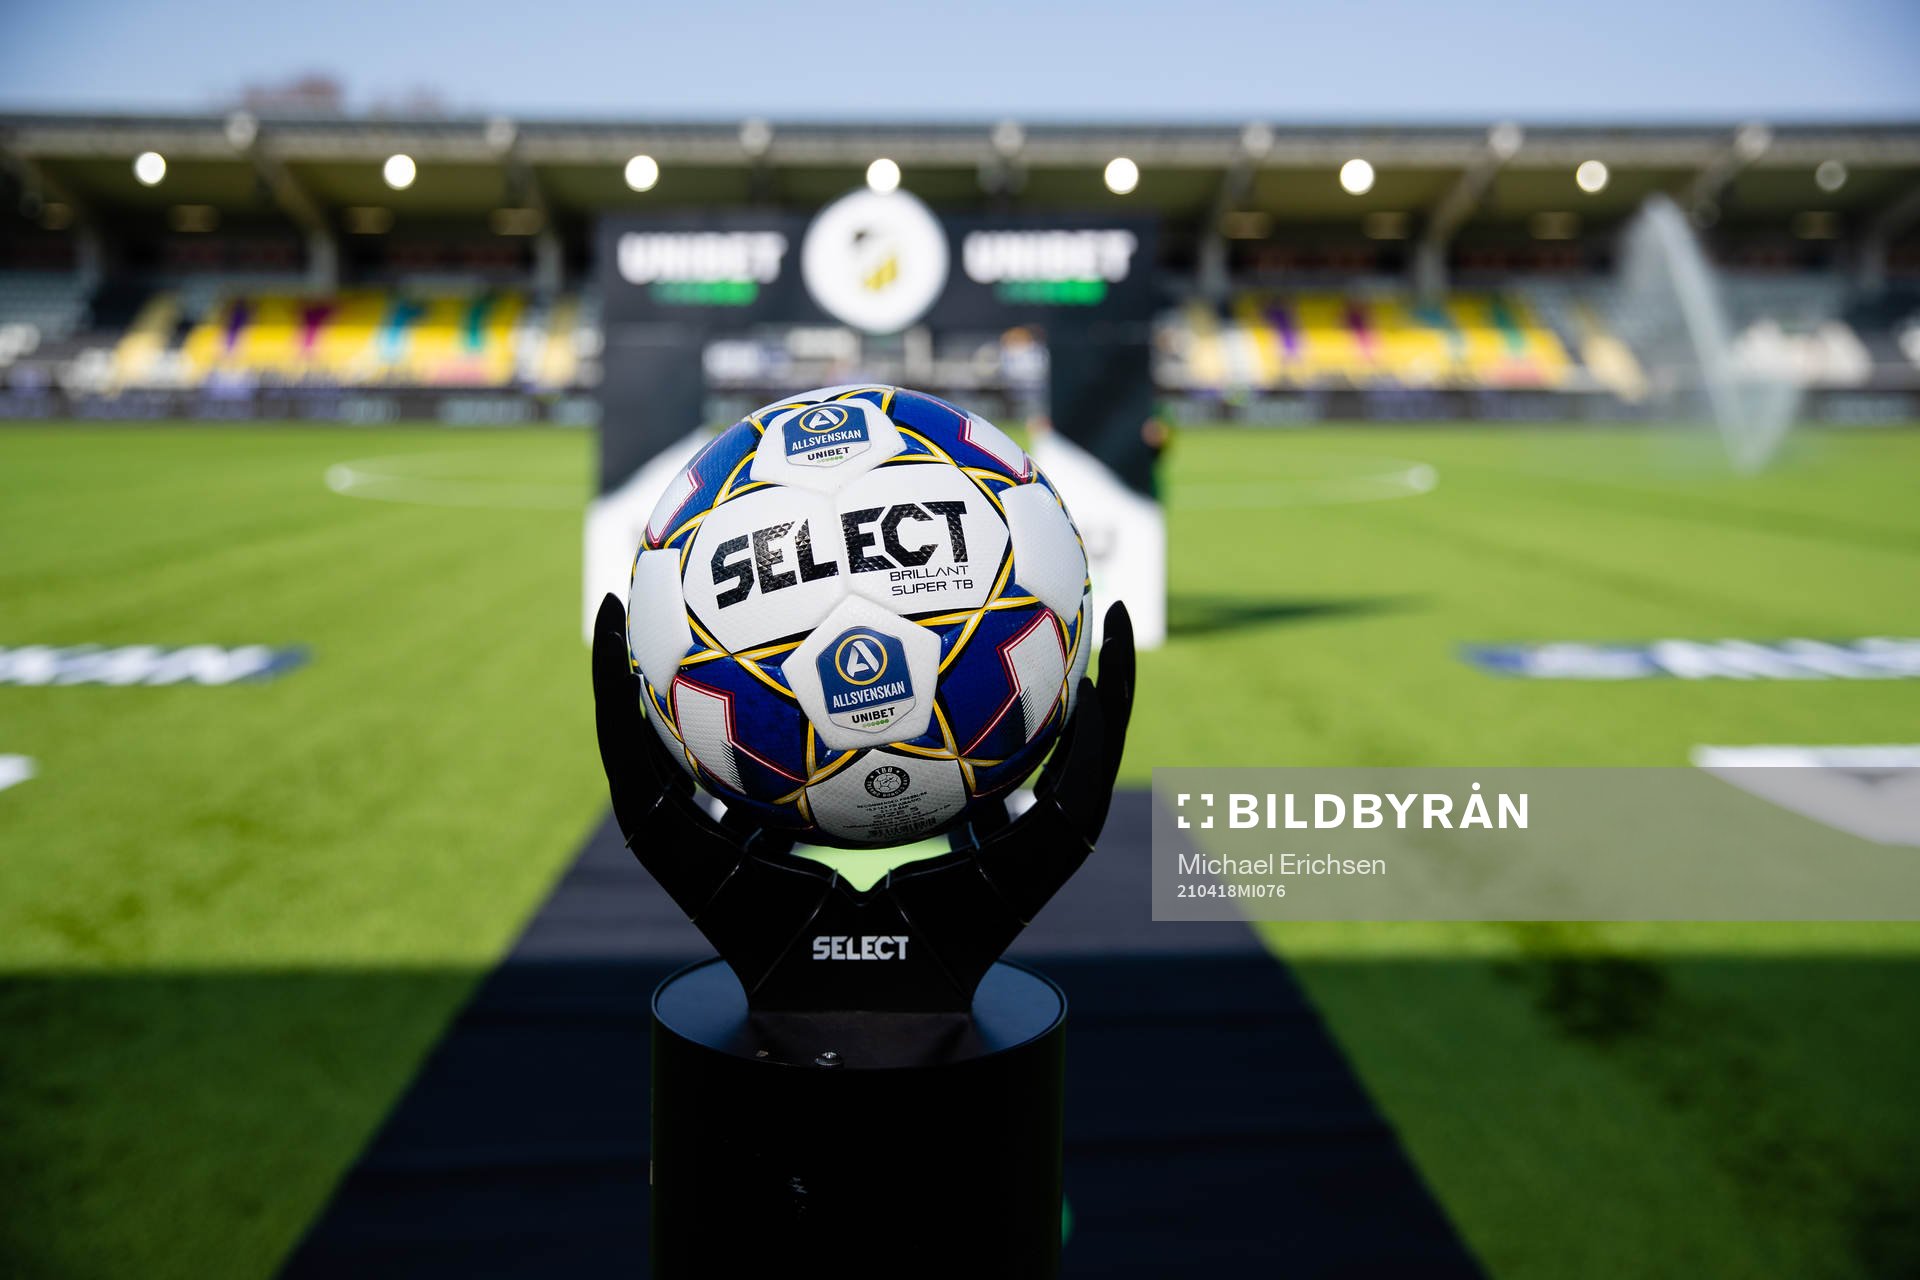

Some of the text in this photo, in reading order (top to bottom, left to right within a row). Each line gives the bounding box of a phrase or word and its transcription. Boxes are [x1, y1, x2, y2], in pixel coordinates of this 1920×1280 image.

[791, 429, 862, 451] ALLSVENSKAN
[807, 446, 850, 461] UNIBET
[711, 501, 968, 609] SELECT
[889, 565, 969, 582] BRILLANT
[891, 579, 974, 596] SUPER TB
[833, 680, 906, 708] ALLSVENSKAN
[852, 706, 895, 723] UNIBET
[812, 936, 909, 960] SELECT
